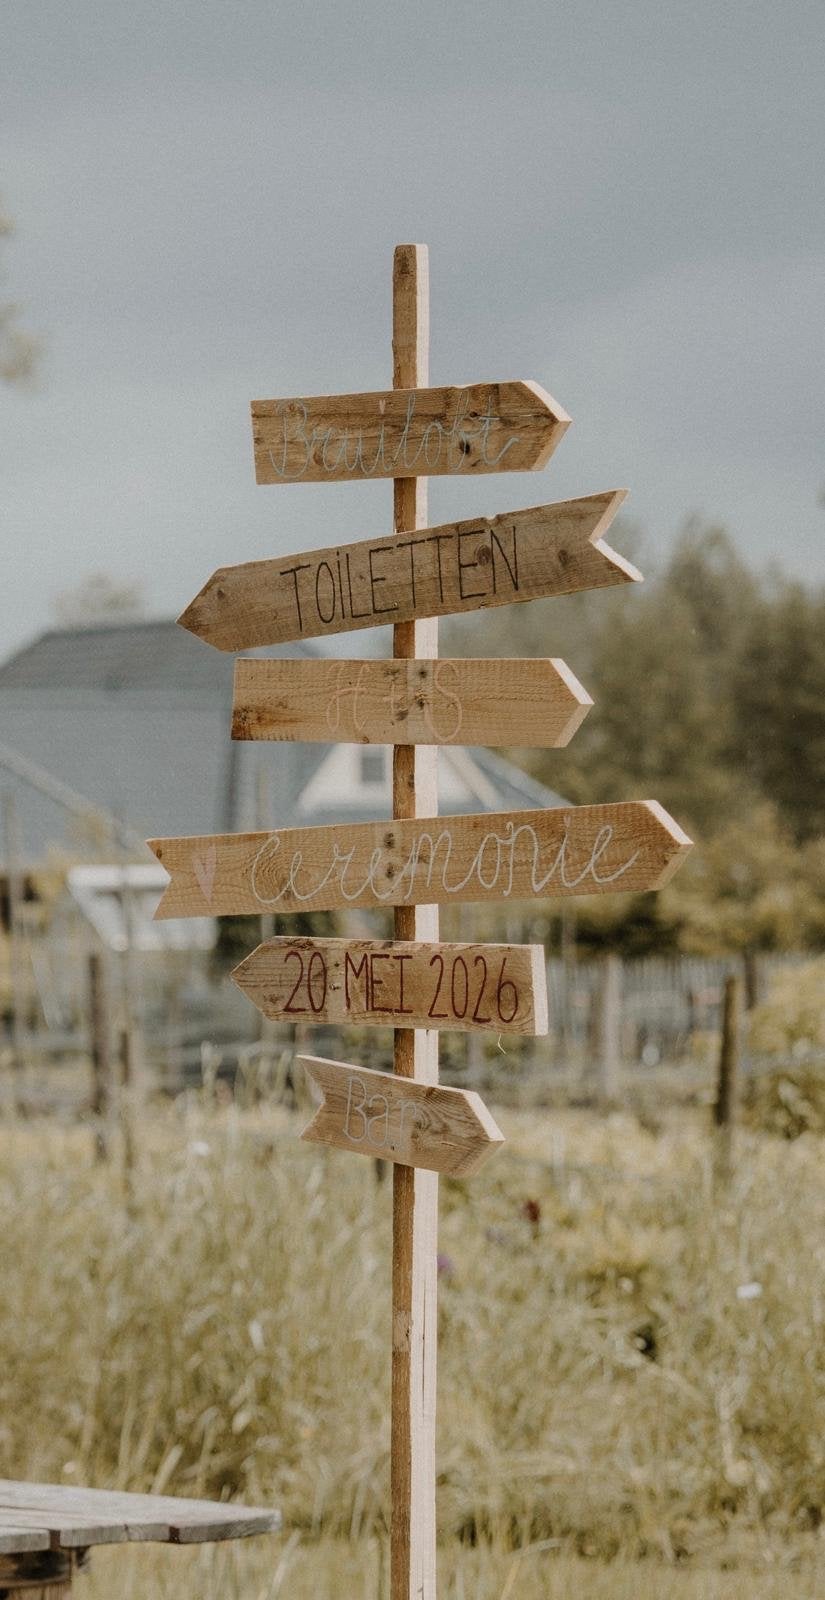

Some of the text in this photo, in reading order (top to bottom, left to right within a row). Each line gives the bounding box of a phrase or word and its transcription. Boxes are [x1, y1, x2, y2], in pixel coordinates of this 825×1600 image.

[251, 815, 640, 903] Ceremonie
[283, 951, 519, 1023] 20 MEI 2026
[343, 1076, 417, 1152] Bar
